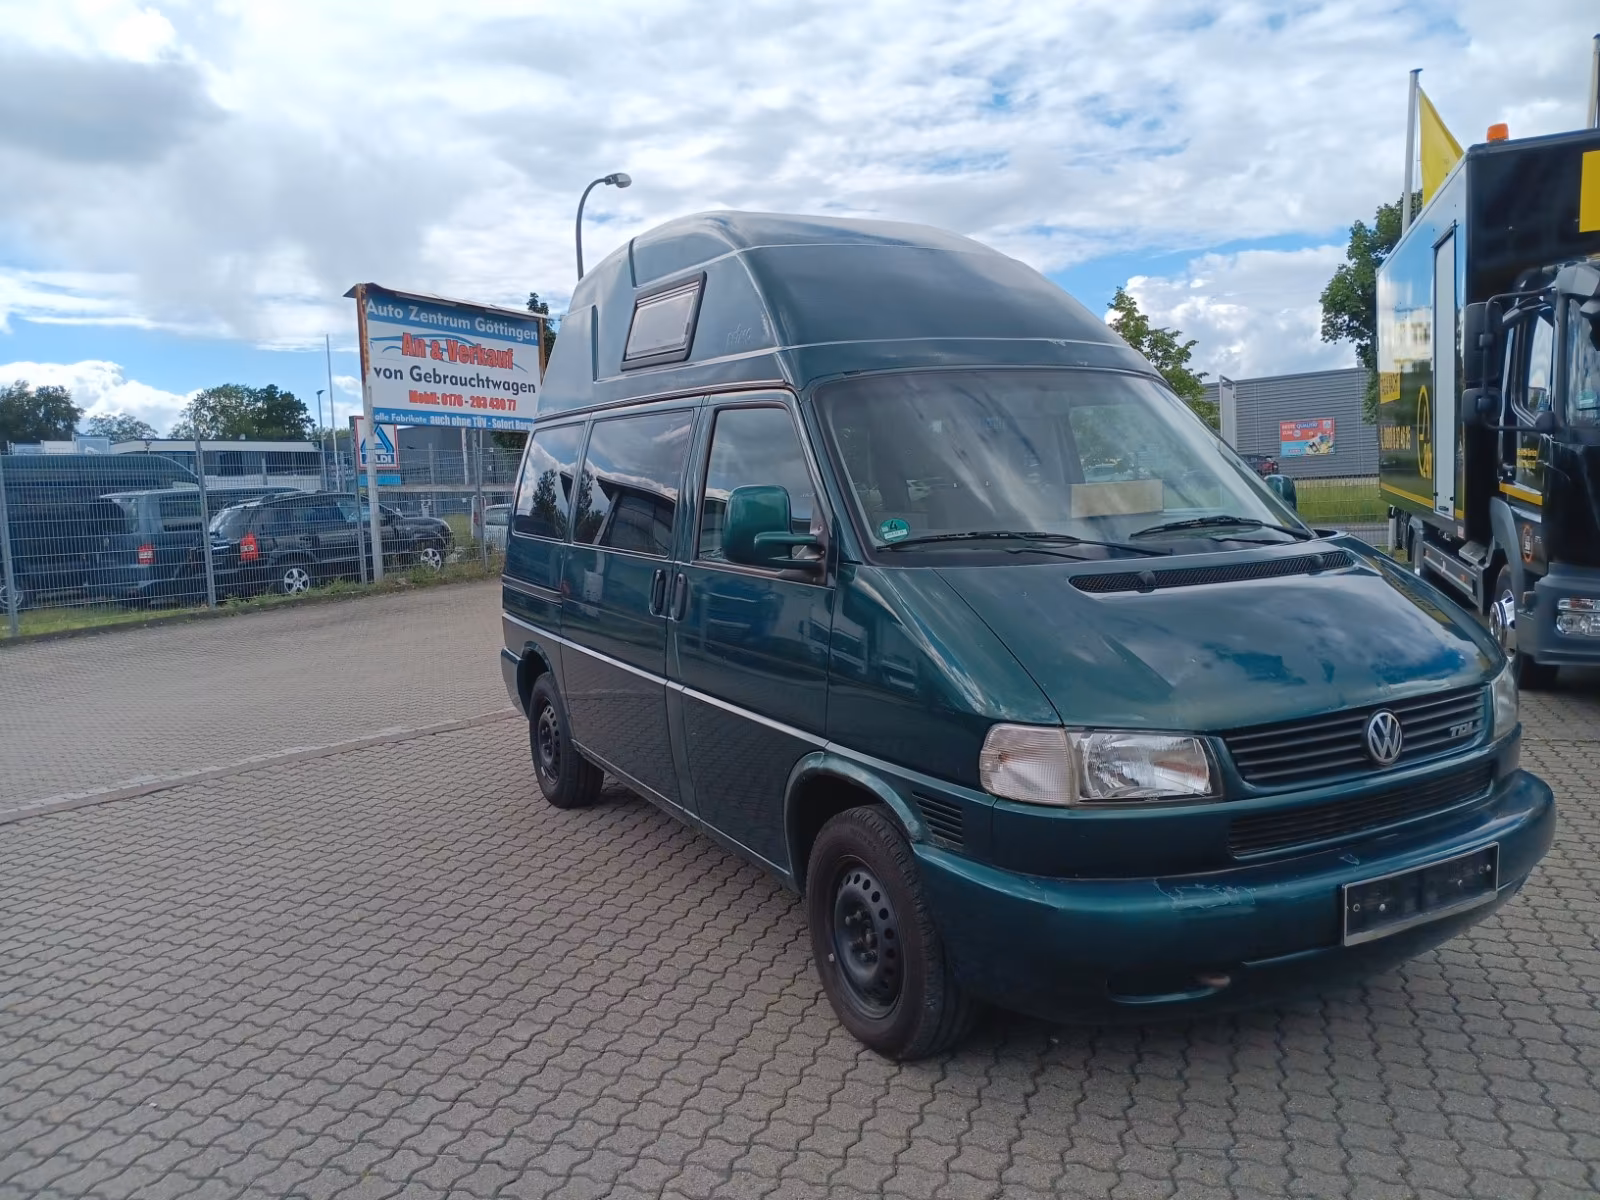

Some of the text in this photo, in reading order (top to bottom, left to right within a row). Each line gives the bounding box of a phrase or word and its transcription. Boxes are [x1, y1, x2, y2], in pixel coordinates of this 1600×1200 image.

[366, 299, 538, 341] Auto Zentrum Göttingen
[402, 332, 514, 370] An & Verkauf
[373, 365, 536, 396] von Gebrauchtwagen
[374, 412, 390, 421] alle
[391, 413, 427, 424] Fabrikate
[430, 415, 450, 426] auch
[451, 416, 472, 427] ohne
[492, 418, 515, 430] Sofort
[1449, 721, 1475, 737] TDI
